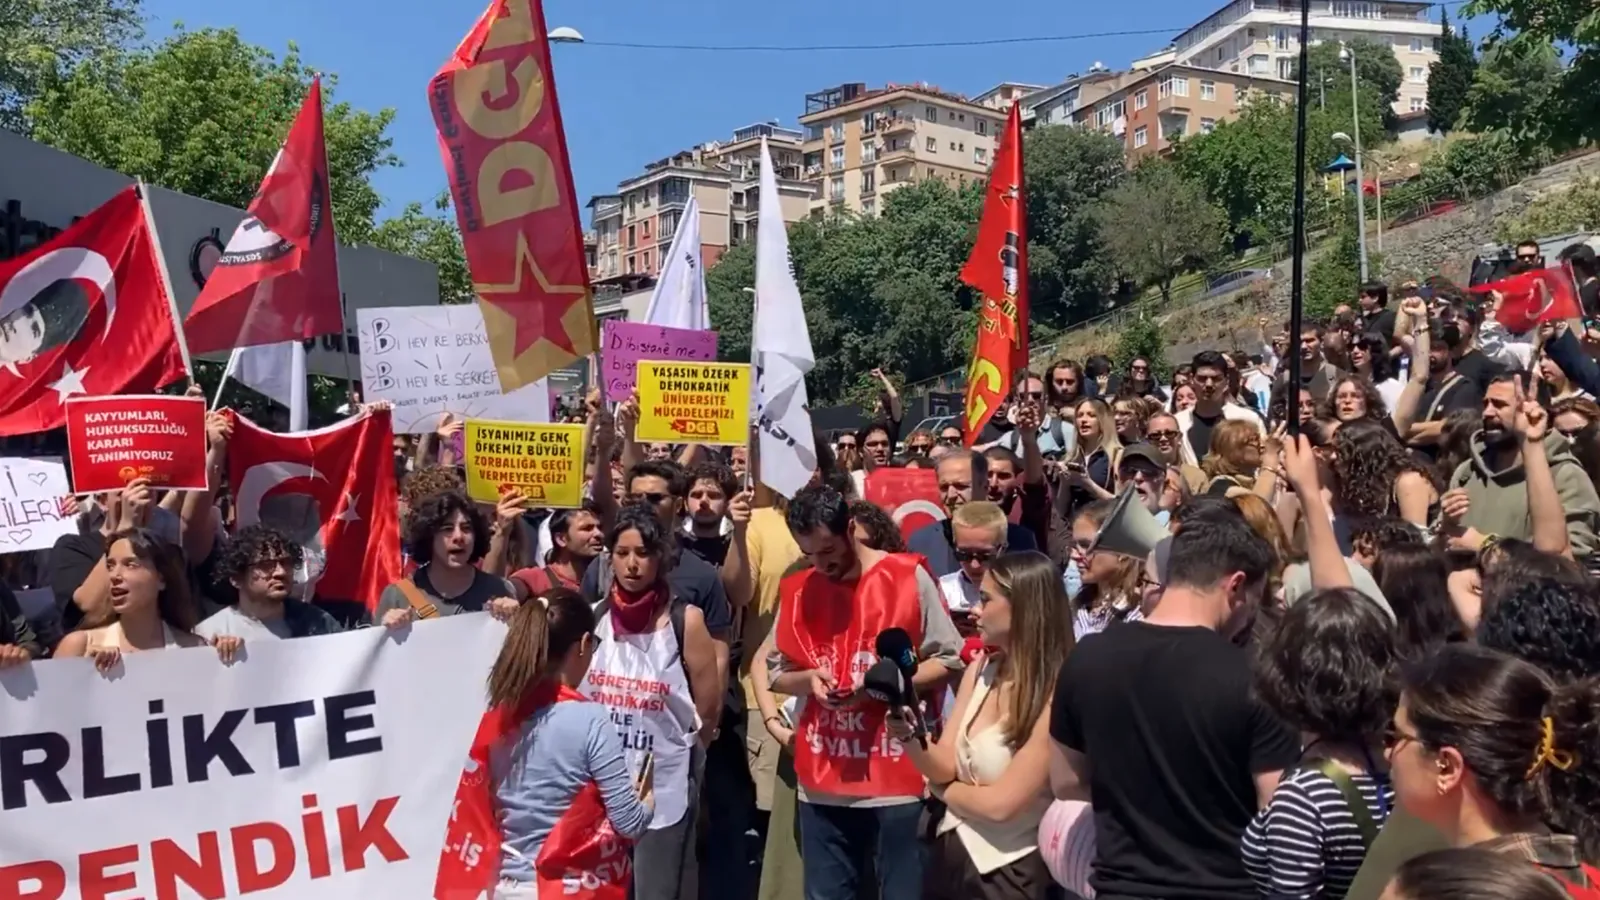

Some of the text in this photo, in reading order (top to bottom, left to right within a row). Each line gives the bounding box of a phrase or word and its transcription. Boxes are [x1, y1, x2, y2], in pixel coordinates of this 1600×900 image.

[434, 335, 449, 347] RE
[434, 373, 450, 386] RE
[652, 366, 739, 381] YAŞASIN ÖZERK
[659, 379, 731, 393] DEMOKRATİK
[662, 391, 726, 406] ÜNİVERSİTE
[84, 410, 169, 423] KAYYUMLARI,
[653, 405, 735, 419] MÜCADELEMİZ!
[85, 422, 188, 437] HUKUKSUZLUĞU,
[686, 420, 716, 434] DGB
[87, 437, 133, 450] KARARI
[477, 427, 570, 446] İSYANIMIZ GENÇ
[475, 440, 571, 457] ÖFKEMİZ BÜYÜK!
[88, 450, 174, 465] TANIMIYORUZ
[474, 455, 573, 472] ZORBALIĞA GEÇİT
[478, 469, 567, 484] VERMEYECEĞİZ!
[588, 667, 671, 696] ÖĞRETMEN
[1, 689, 384, 811] RLİKTE
